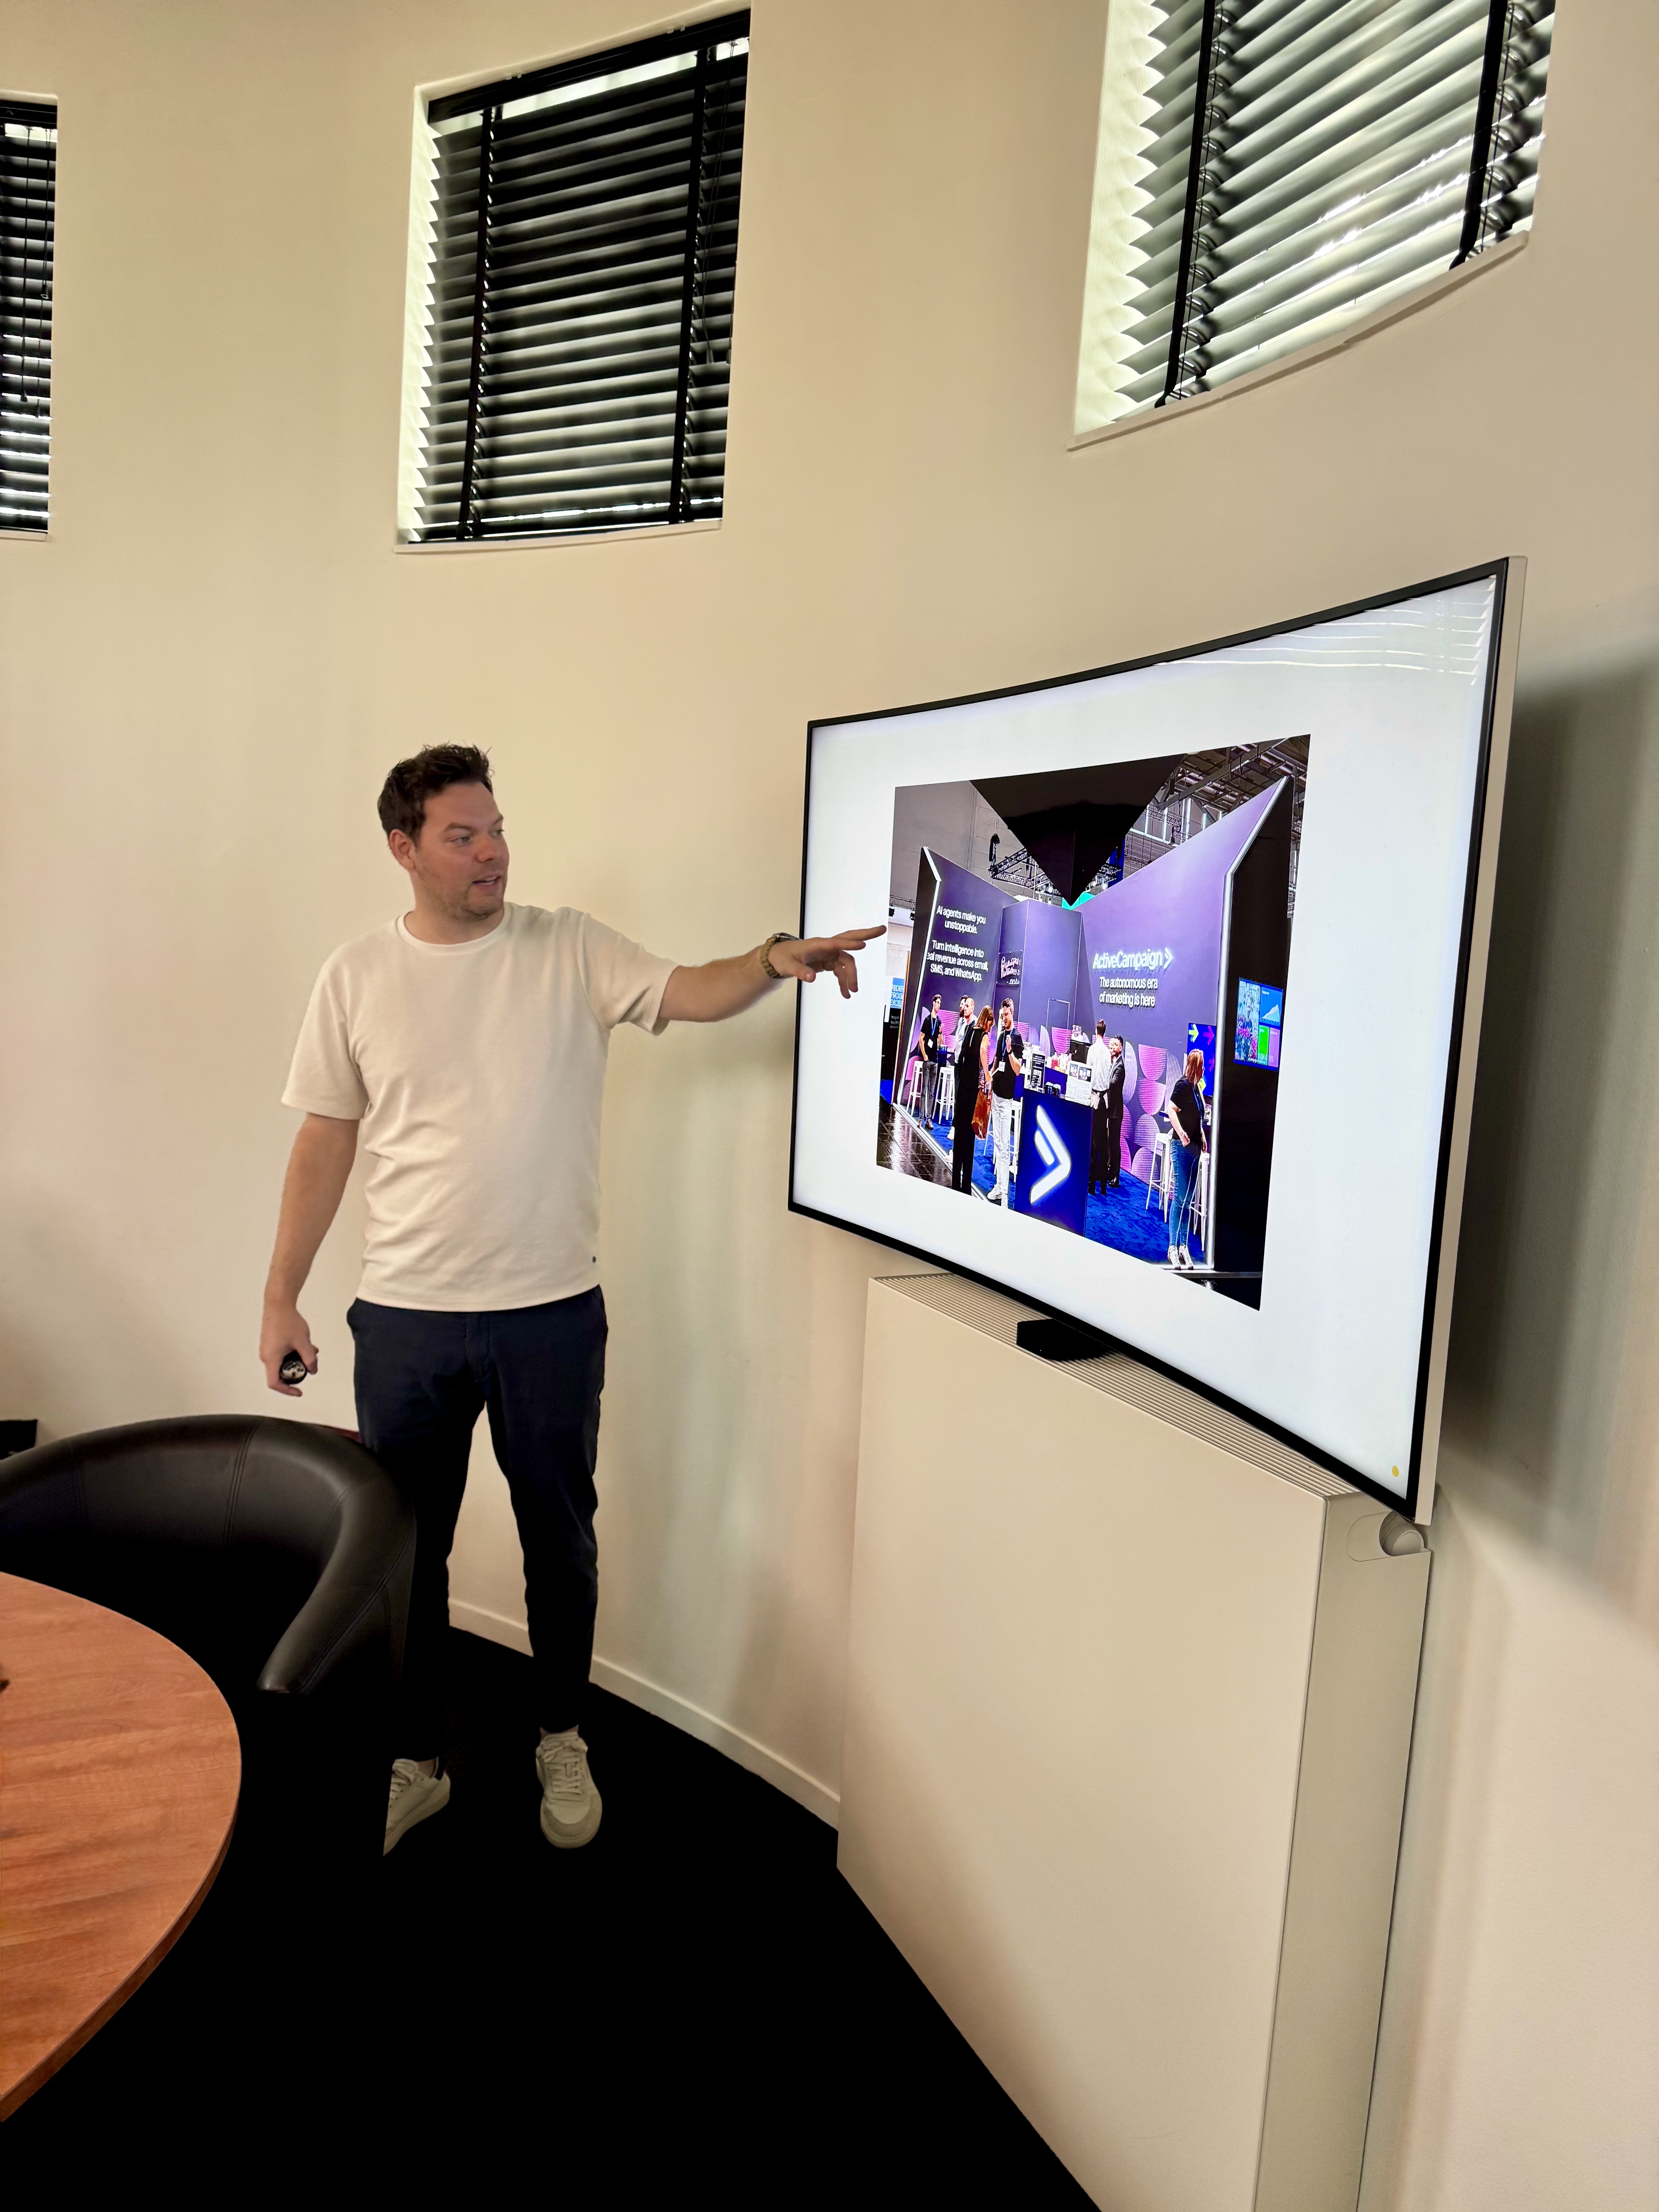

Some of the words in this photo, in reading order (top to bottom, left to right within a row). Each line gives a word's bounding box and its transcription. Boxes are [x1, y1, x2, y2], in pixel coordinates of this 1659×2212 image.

[936, 905, 943, 915] AI
[943, 908, 962, 919] agents
[962, 912, 976, 922] make
[976, 915, 986, 924] you
[945, 920, 977, 934] unstoppable.
[932, 940, 945, 950] Turn
[935, 954, 957, 965] revenue
[957, 958, 974, 968] across
[974, 961, 988, 972] email,
[1092, 948, 1163, 971] ActiveCampaign
[930, 963, 944, 975] SMS,
[944, 967, 955, 977] and
[955, 968, 982, 982] WhatsApp.
[1099, 976, 1109, 988] The
[1109, 977, 1146, 989] autonomous
[1147, 978, 1158, 989] era
[1099, 991, 1106, 1003] of
[1106, 992, 1133, 1008] marketing
[1134, 993, 1140, 1006] is
[1140, 993, 1156, 1007] here
